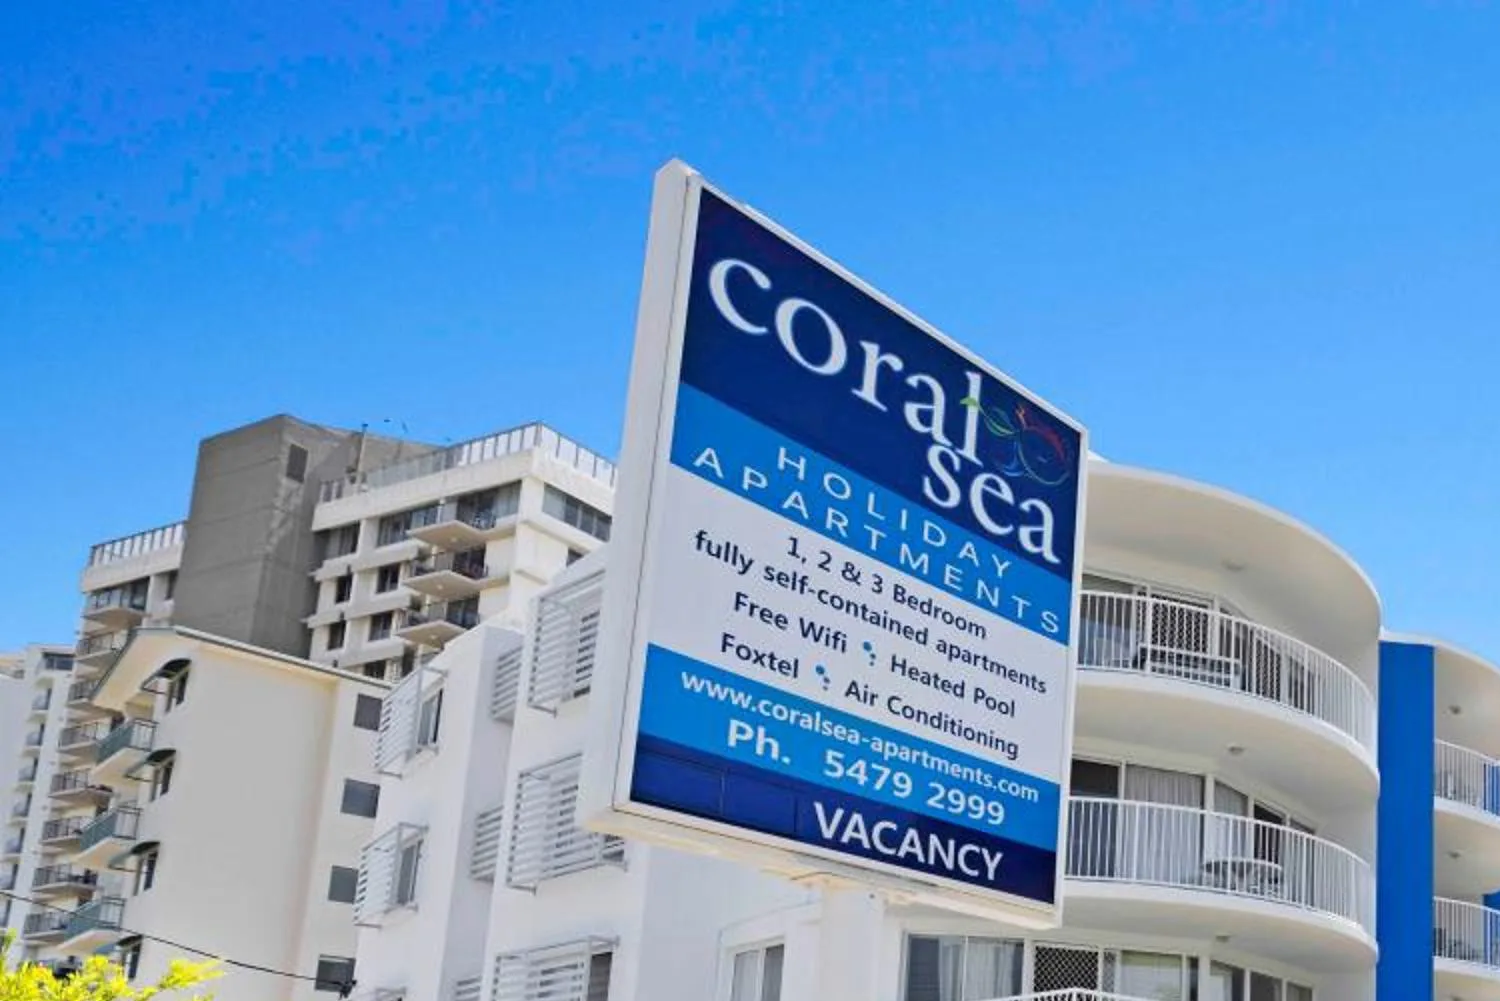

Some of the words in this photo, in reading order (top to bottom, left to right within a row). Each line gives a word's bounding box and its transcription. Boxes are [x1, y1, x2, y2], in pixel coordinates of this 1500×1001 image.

[707, 258, 982, 466] coral
[693, 446, 1060, 634] APARTMENTS
[777, 446, 1012, 579] HOLIDAY
[922, 444, 1062, 565] sea
[694, 529, 755, 576] fully
[762, 564, 929, 647] self-contained
[935, 637, 1047, 695] apartments
[786, 536, 807, 565] 1,
[817, 550, 833, 573] 2
[840, 560, 862, 587] &
[871, 572, 884, 595] 3
[892, 582, 988, 640] Bedroom
[720, 631, 800, 679] Foxtel
[844, 679, 879, 707] Air
[886, 694, 1020, 762] Conditioning
[733, 590, 789, 632] Free
[799, 616, 848, 654] Wifi
[890, 653, 966, 699] Heated
[973, 686, 1016, 719] Pool
[680, 670, 1040, 804] www.coralsea-apartments.com
[727, 718, 792, 766] Ph.
[823, 749, 913, 799] 5479
[926, 781, 1006, 826] 2999
[812, 800, 1005, 882] VACANCY
